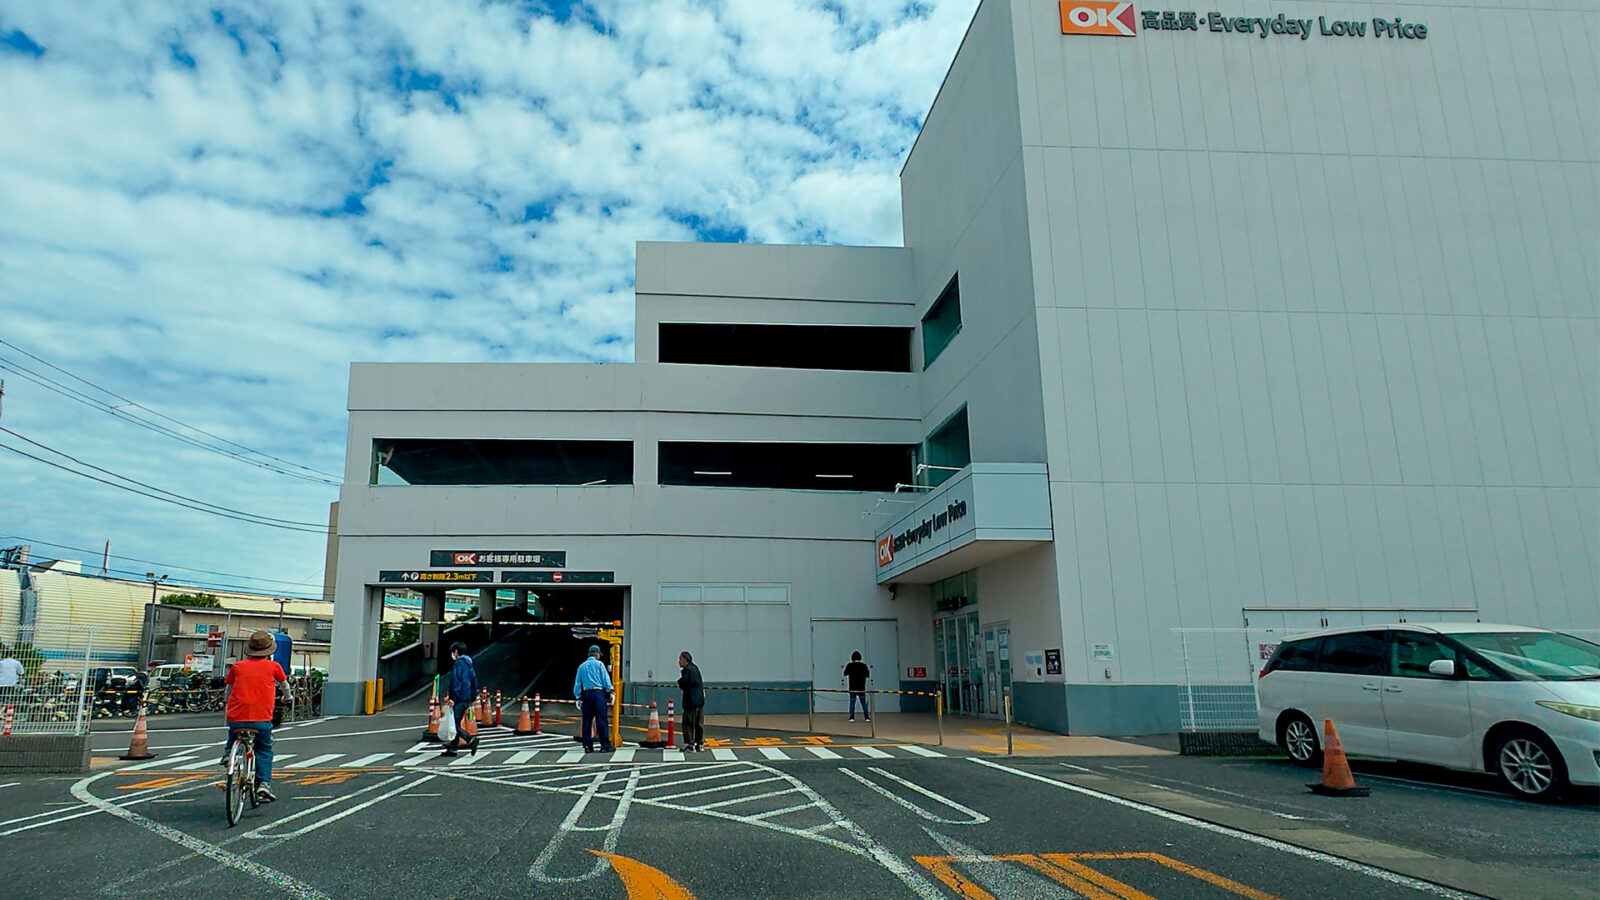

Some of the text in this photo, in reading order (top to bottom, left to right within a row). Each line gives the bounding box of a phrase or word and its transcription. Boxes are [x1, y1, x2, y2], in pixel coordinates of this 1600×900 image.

[1069, 3, 1136, 36] OK
[1319, 16, 1366, 37] Low
[1373, 18, 1428, 39] Price
[457, 554, 476, 564] OK
[880, 535, 893, 562] OK
